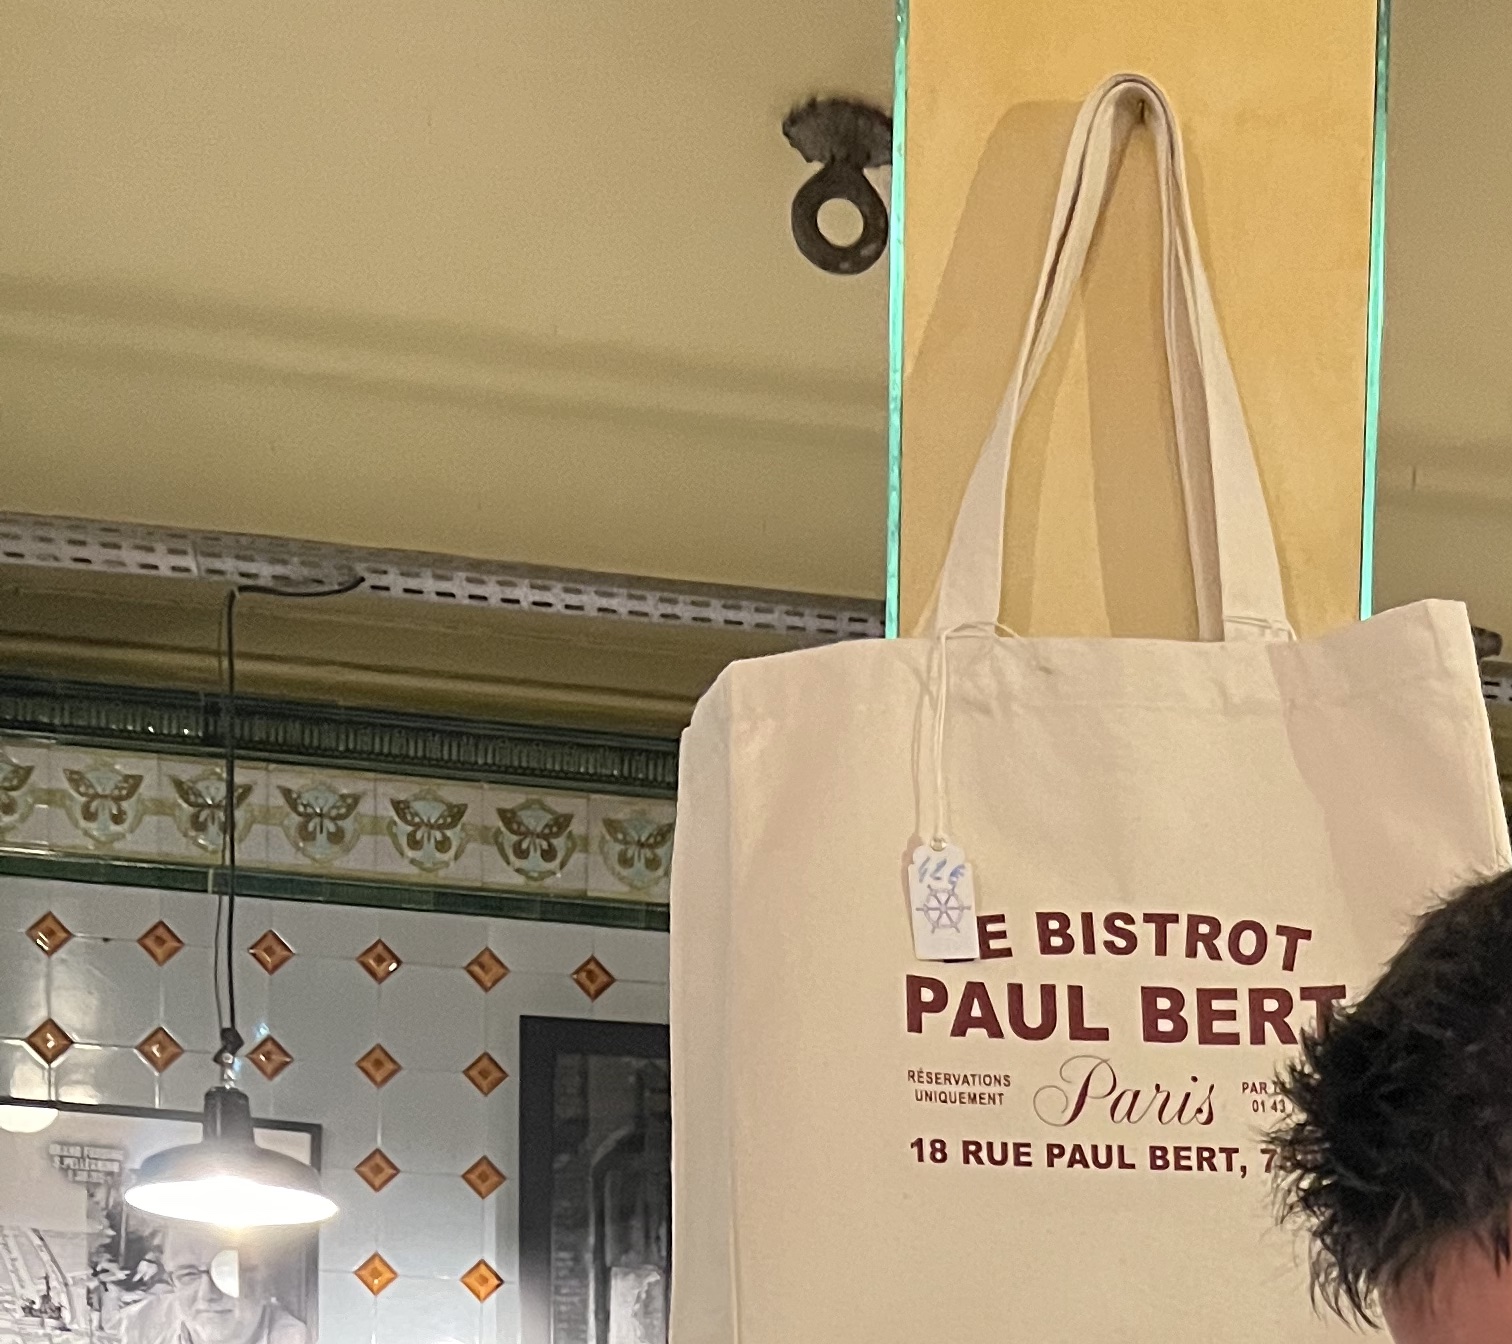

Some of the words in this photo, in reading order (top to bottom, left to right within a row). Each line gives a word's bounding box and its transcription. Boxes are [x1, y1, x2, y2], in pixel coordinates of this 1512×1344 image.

[1035, 911, 1312, 972] BISTROT
[906, 974, 1109, 1042] PAUL
[908, 1068, 1011, 1087] RÉSERVATIONS
[1033, 1055, 1215, 1127] Paris
[1242, 1081, 1268, 1094] PAR
[915, 1089, 1005, 1106] UNIQUEMENT
[1252, 1099, 1265, 1112] 01
[910, 1137, 948, 1164] 18
[962, 1139, 1032, 1167] RUE
[1046, 1143, 1136, 1170] PAUL
[1147, 1145, 1247, 1179] BERT,
